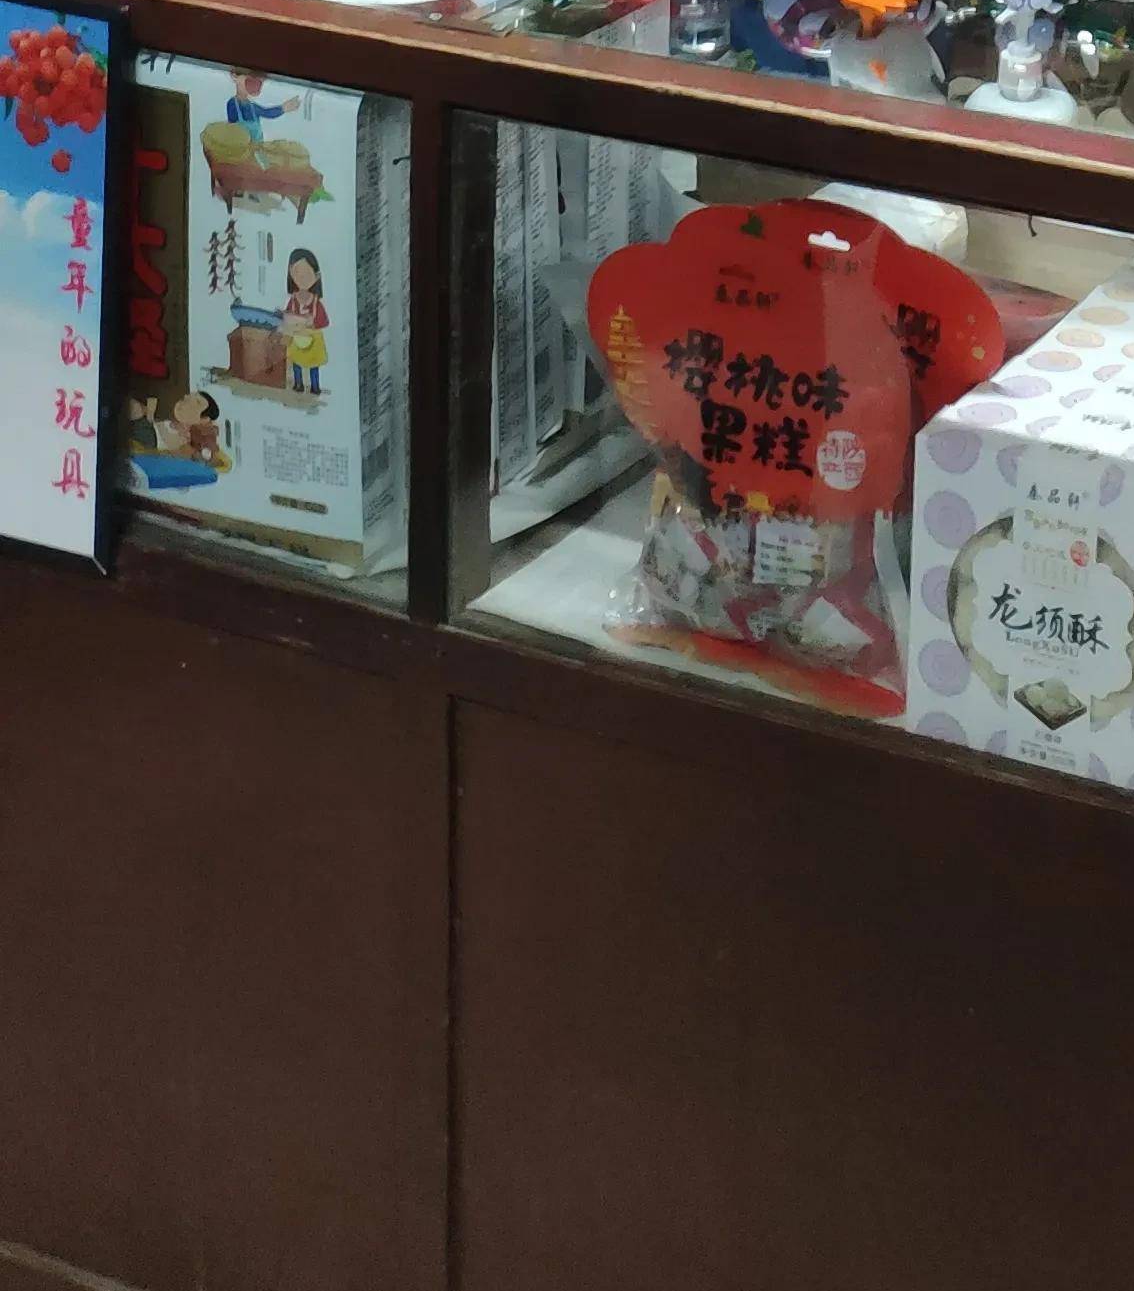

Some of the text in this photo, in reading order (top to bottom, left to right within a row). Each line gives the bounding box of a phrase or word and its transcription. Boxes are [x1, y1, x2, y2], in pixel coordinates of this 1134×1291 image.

[52, 196, 96, 499] 童年的玩具
[988, 582, 1110, 655] 龙须酥
